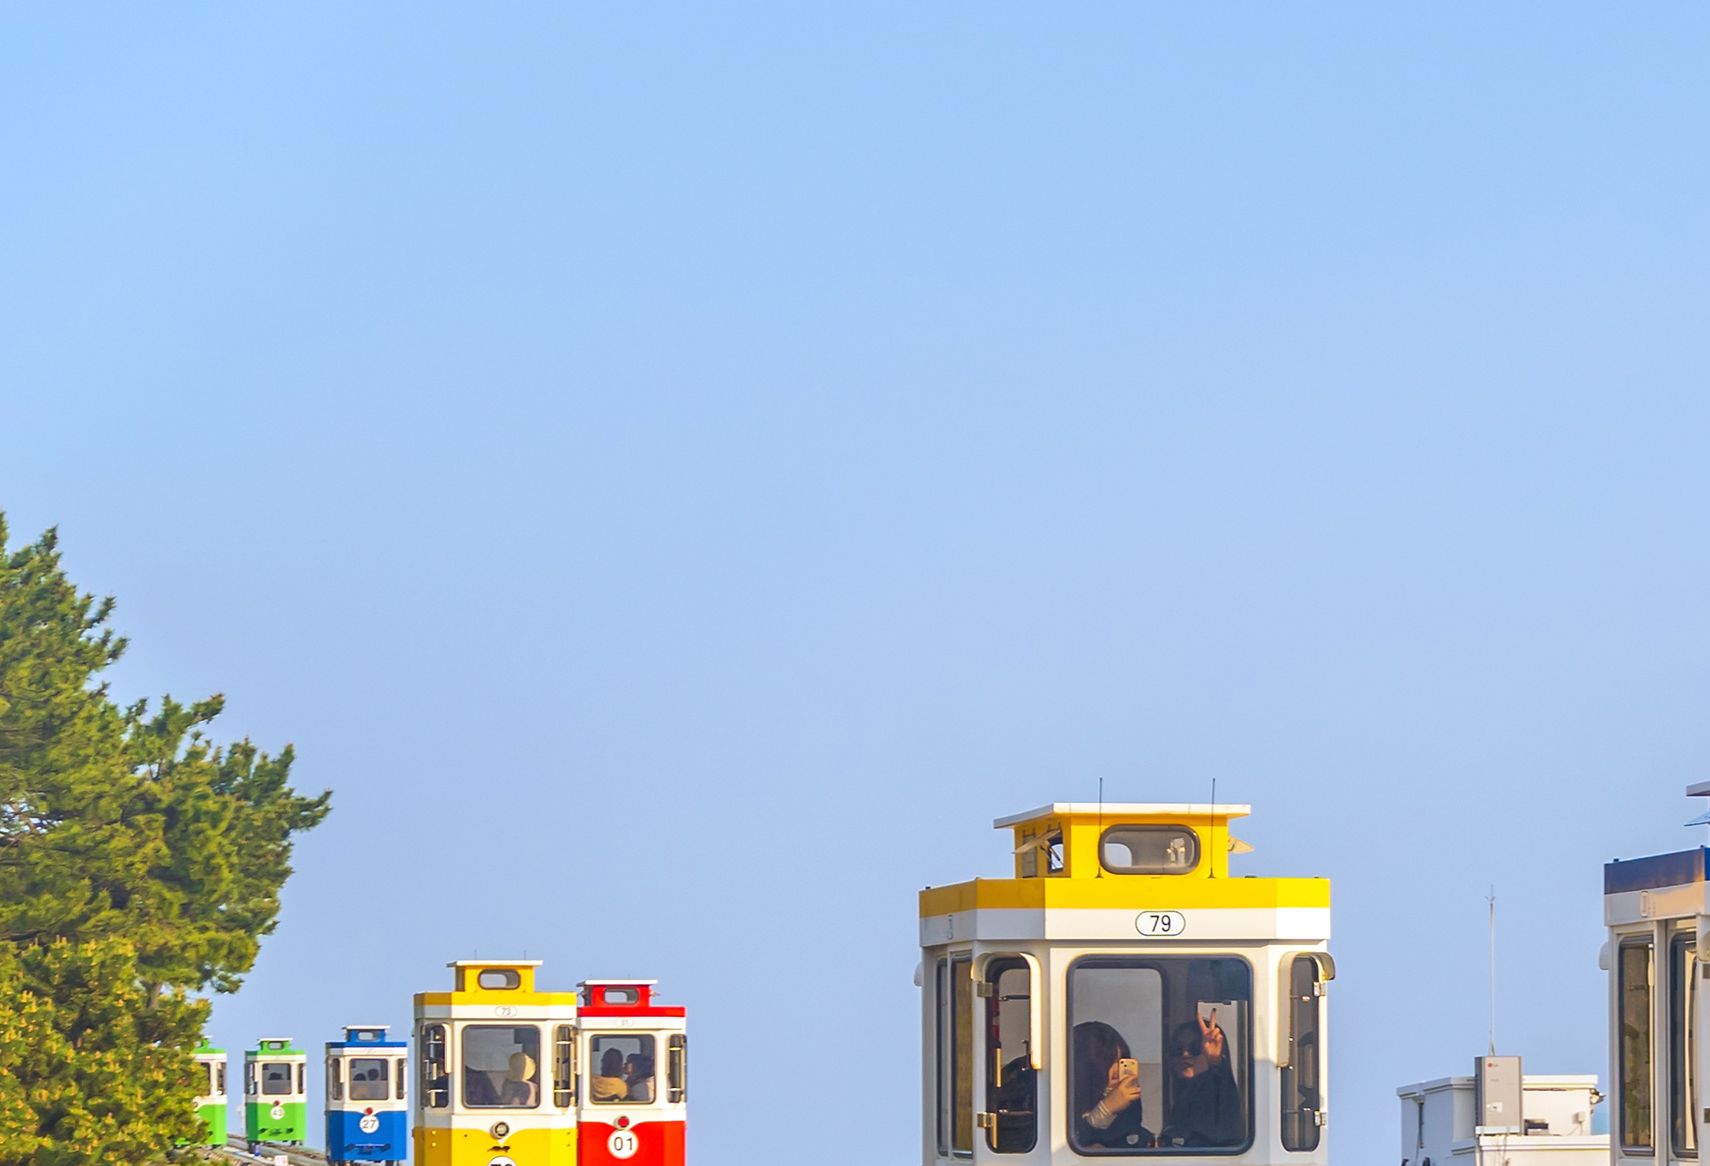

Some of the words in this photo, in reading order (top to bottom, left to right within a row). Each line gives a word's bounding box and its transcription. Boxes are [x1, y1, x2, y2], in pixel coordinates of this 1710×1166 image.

[1150, 915, 1171, 932] 79
[501, 1008, 512, 1016] 73
[362, 1119, 376, 1129] 27
[614, 1137, 633, 1151] 01
